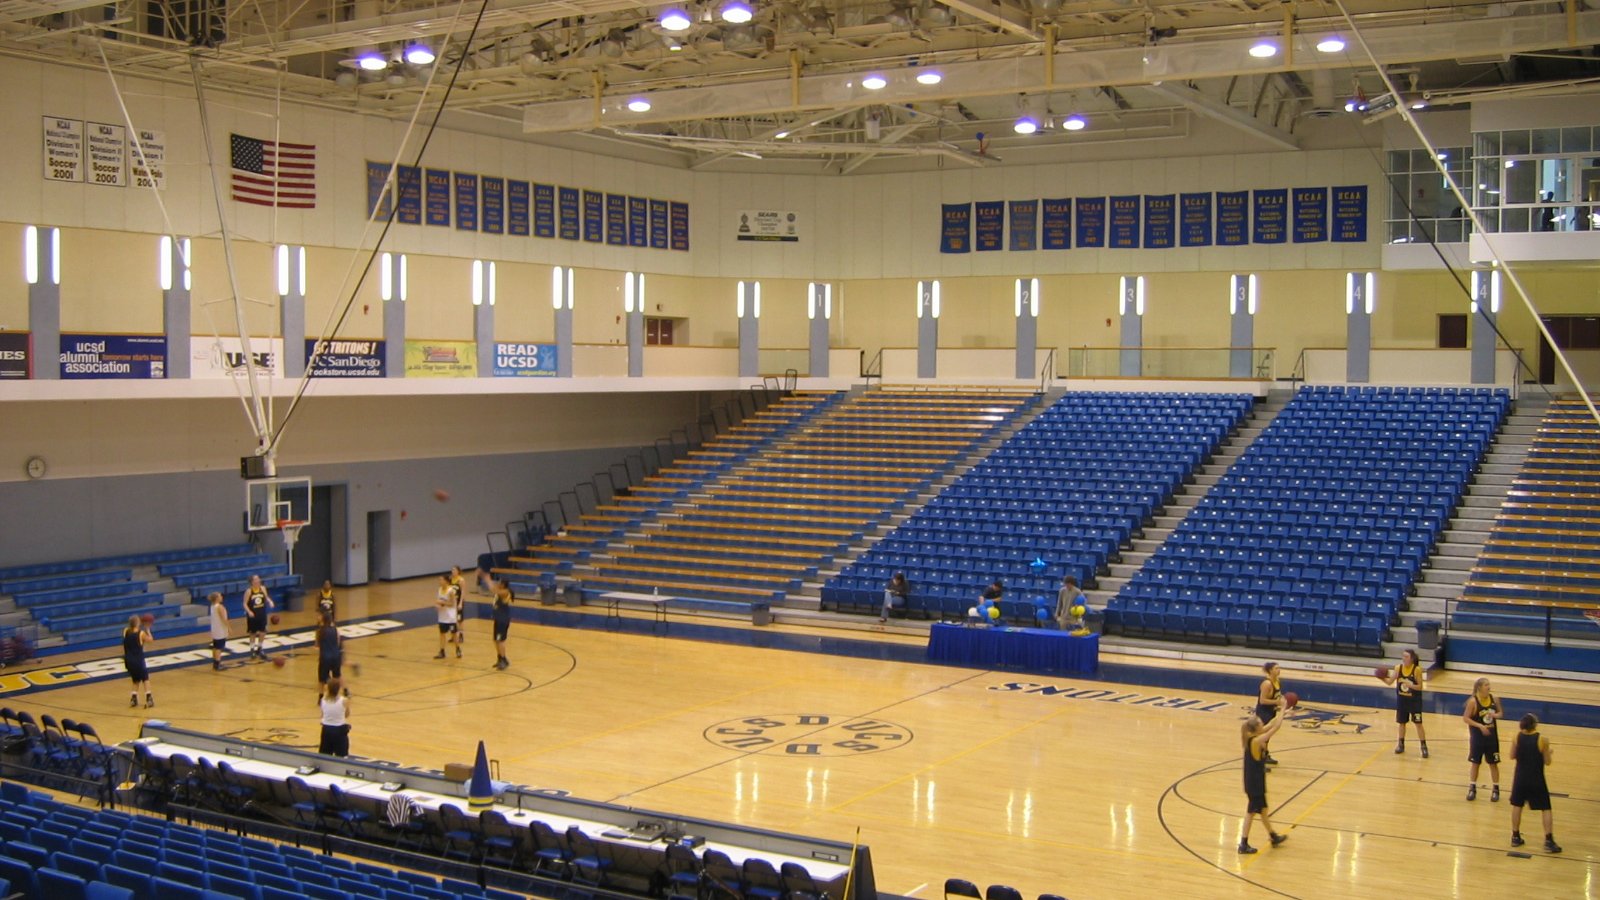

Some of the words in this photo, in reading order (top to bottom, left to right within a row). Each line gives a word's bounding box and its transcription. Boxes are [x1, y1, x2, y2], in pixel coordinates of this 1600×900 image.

[131, 150, 158, 159] Diision
[49, 157, 77, 169] Soccer
[93, 162, 120, 174] Soccer
[53, 169, 74, 180] 2001
[95, 174, 117, 183] 2000
[1022, 291, 1029, 304] 2
[1127, 288, 1134, 302] 3
[1238, 287, 1245, 301] 3
[1353, 286, 1361, 300] 4
[1479, 284, 1488, 299] 4
[923, 292, 930, 305] 2
[76, 341, 106, 353] ucsd
[329, 342, 370, 354] TRITONS
[497, 344, 538, 356] READ
[60, 351, 100, 364] alumni
[497, 356, 538, 368] UCSD
[65, 362, 130, 374] association
[986, 681, 1232, 713] TRITONS
